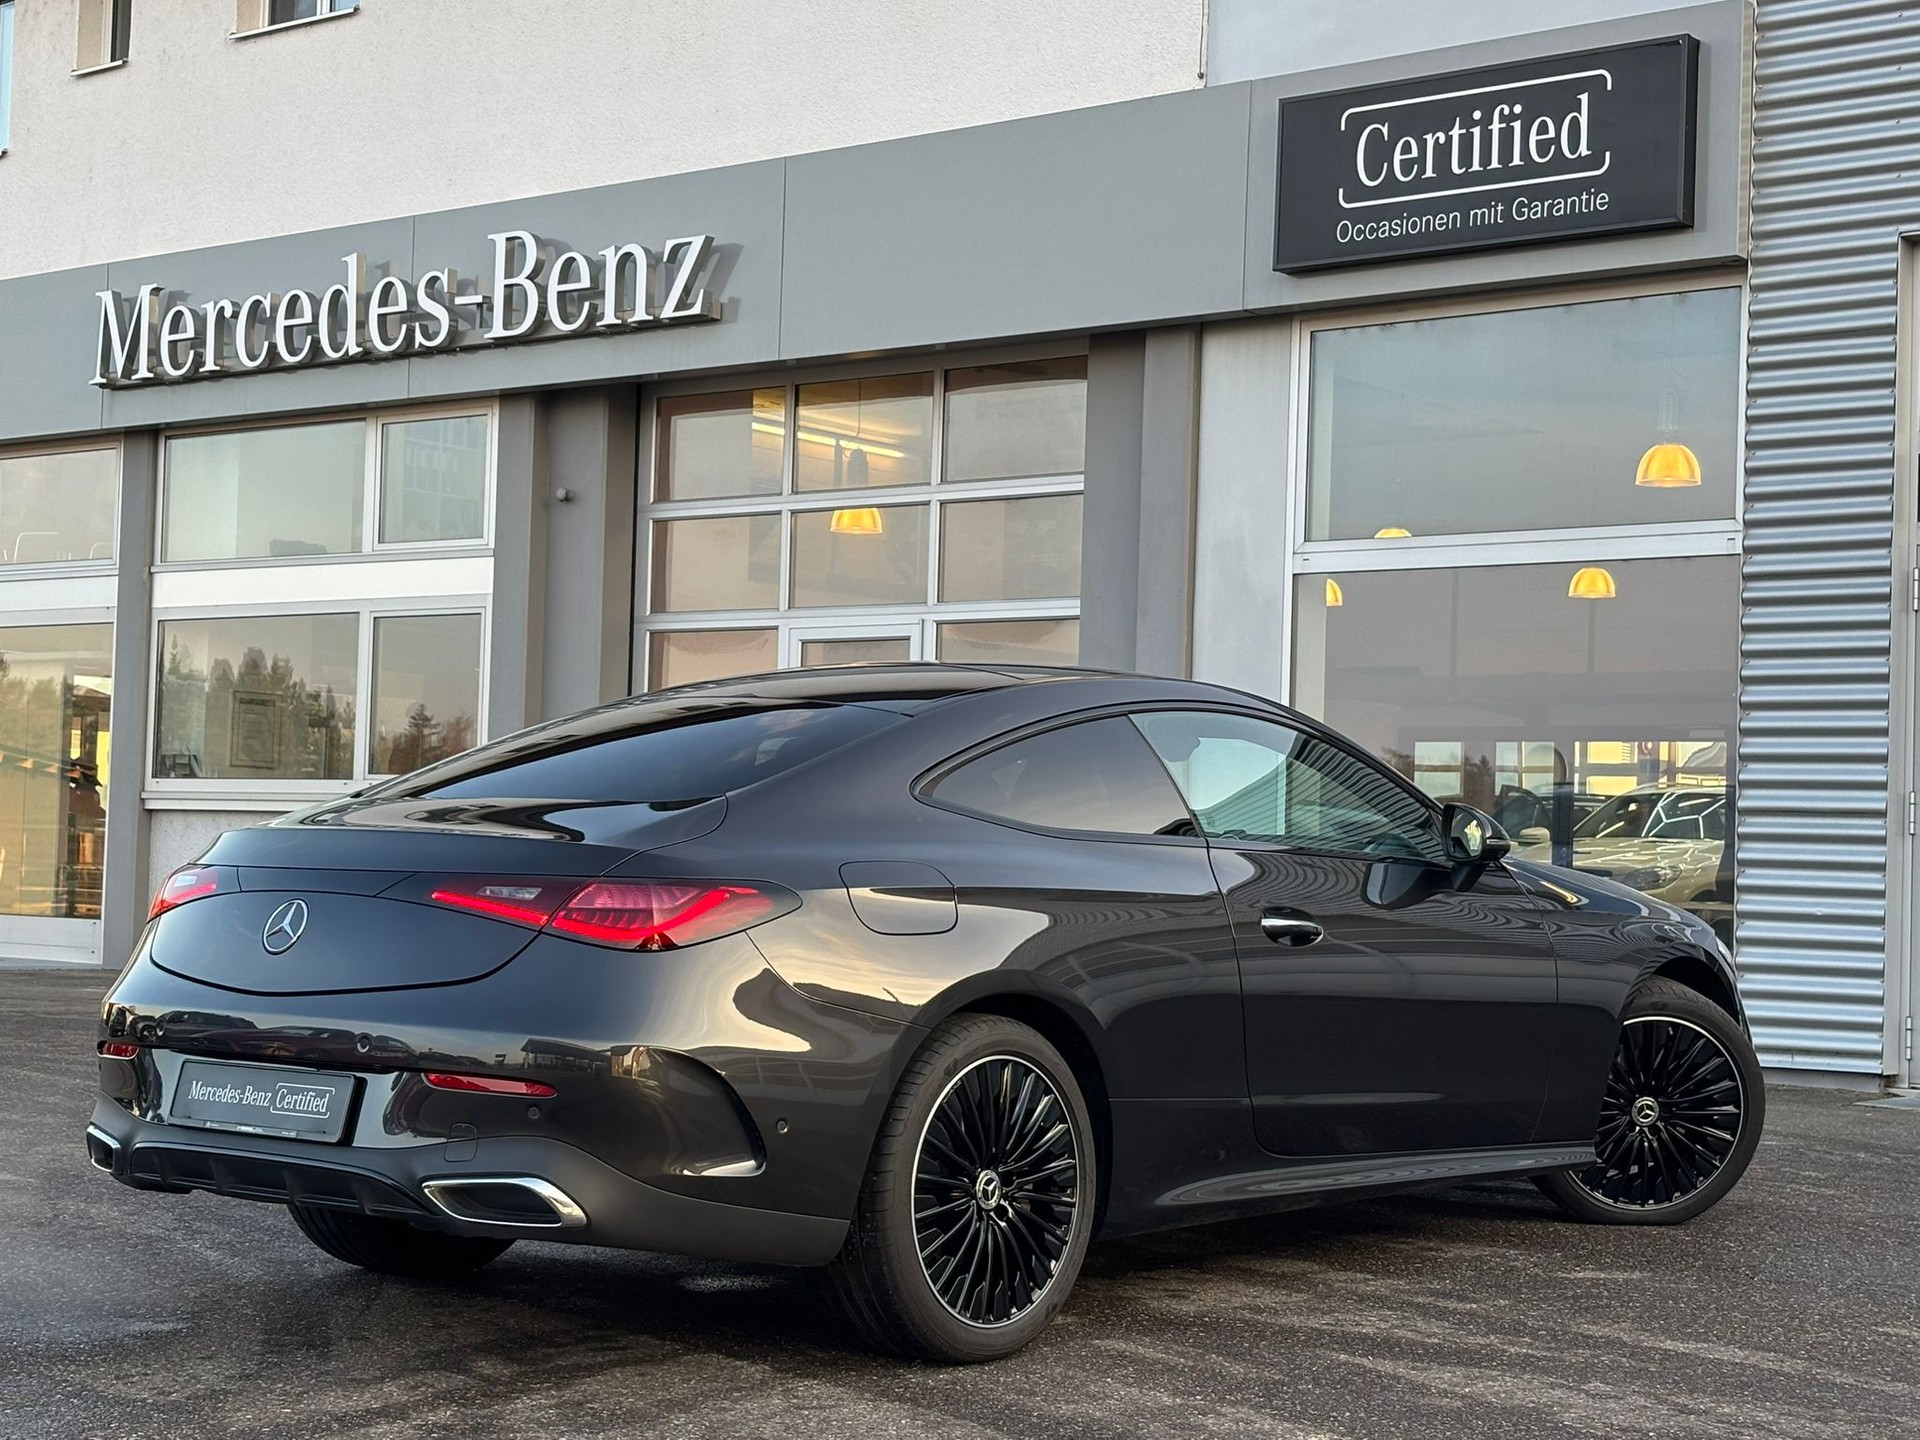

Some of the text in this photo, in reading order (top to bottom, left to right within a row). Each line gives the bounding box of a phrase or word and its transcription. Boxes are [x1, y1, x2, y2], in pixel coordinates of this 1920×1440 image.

[1355, 91, 1593, 188] Certified
[1336, 188, 1610, 243] Occasionen mit Garantie
[88, 230, 712, 385] Mercedes-Benz
[188, 1080, 330, 1113] Mercedes-Benz Certified
